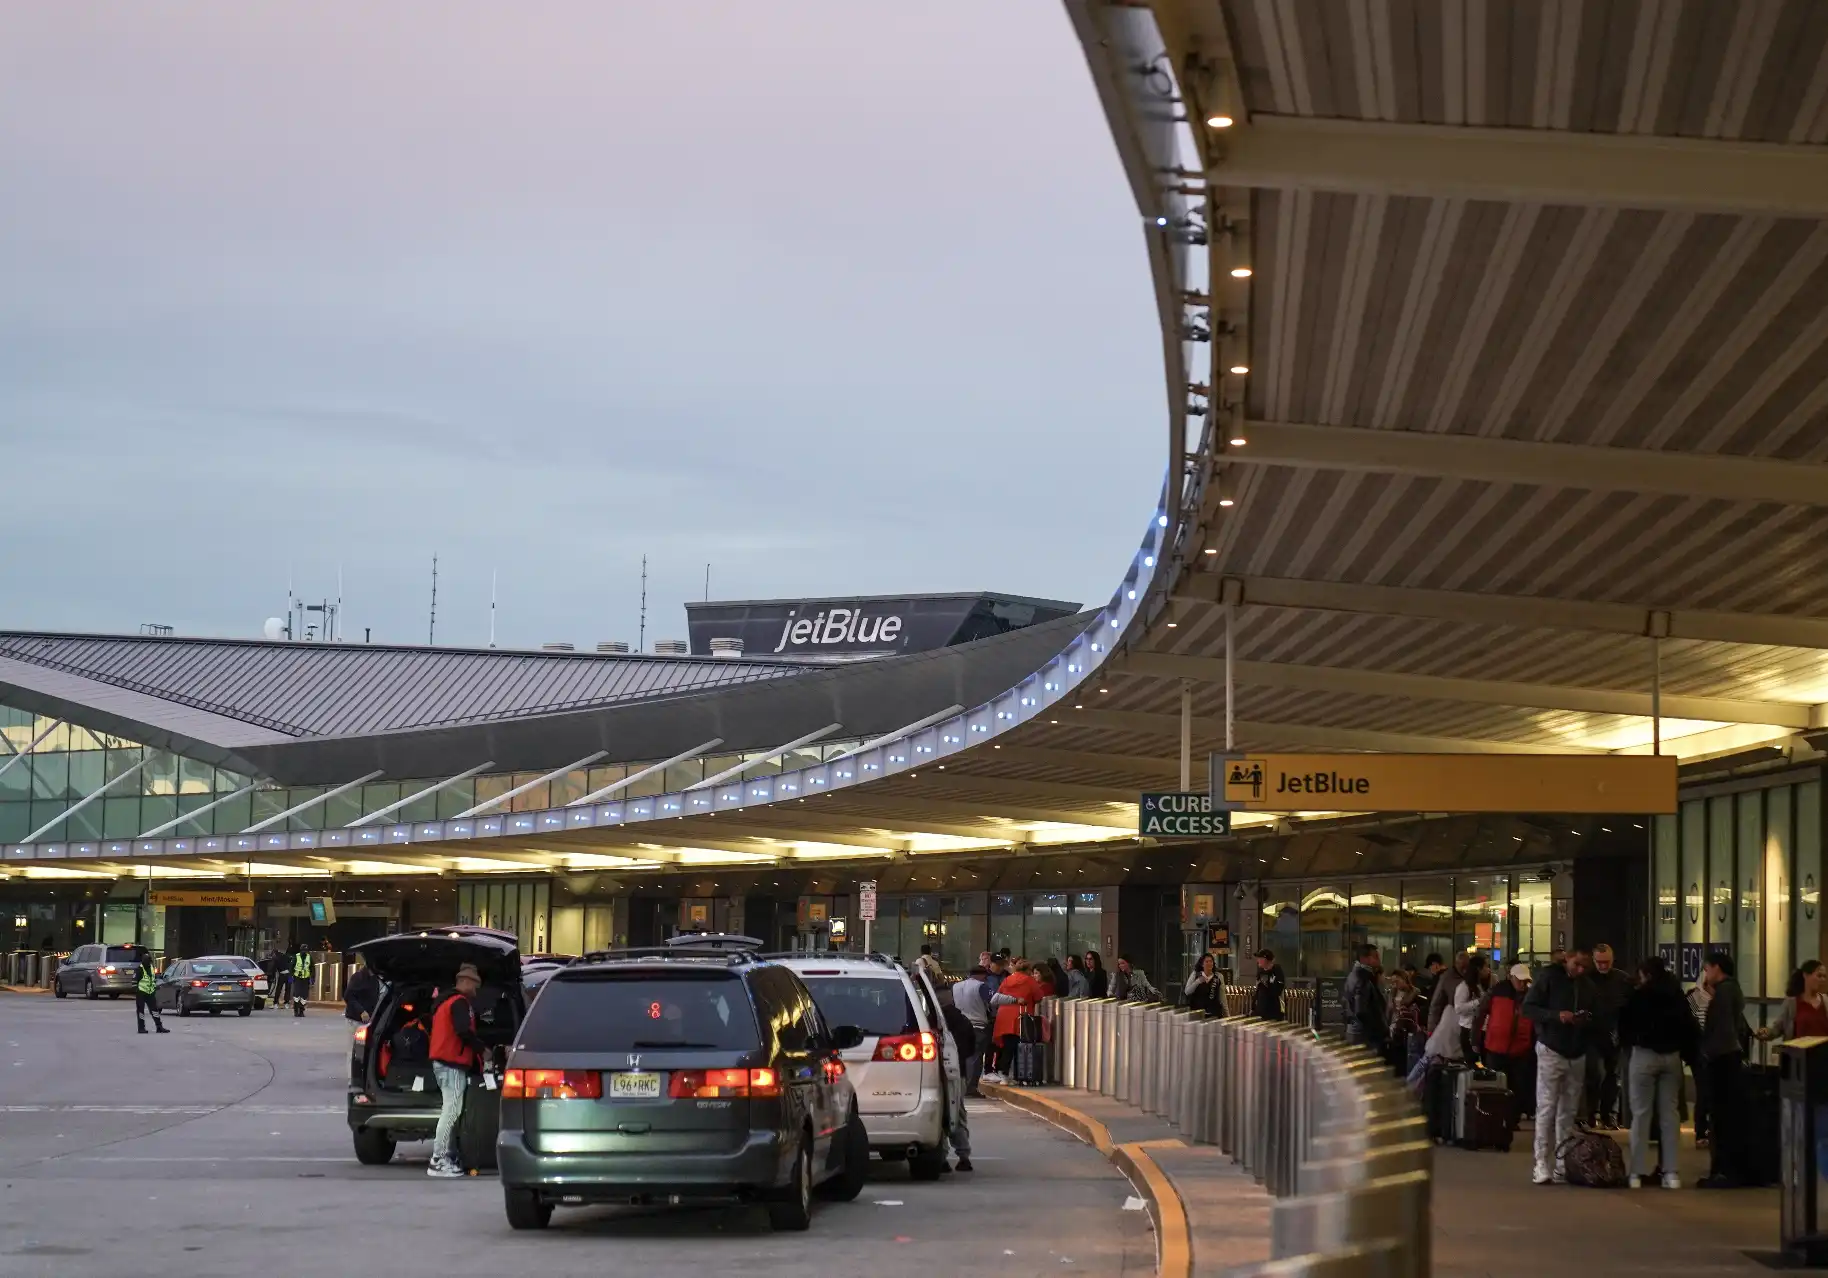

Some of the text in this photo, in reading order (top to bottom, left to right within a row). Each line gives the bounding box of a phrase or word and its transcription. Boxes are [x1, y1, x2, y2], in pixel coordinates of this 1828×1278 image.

[773, 608, 902, 653] jetBlue
[1276, 771, 1370, 794] JetBlue
[1158, 795, 1212, 813] CURB
[1145, 816, 1225, 834] ACCESS
[200, 895, 240, 903] Mint/Mosaic
[613, 1079, 657, 1092] L96 RKC
